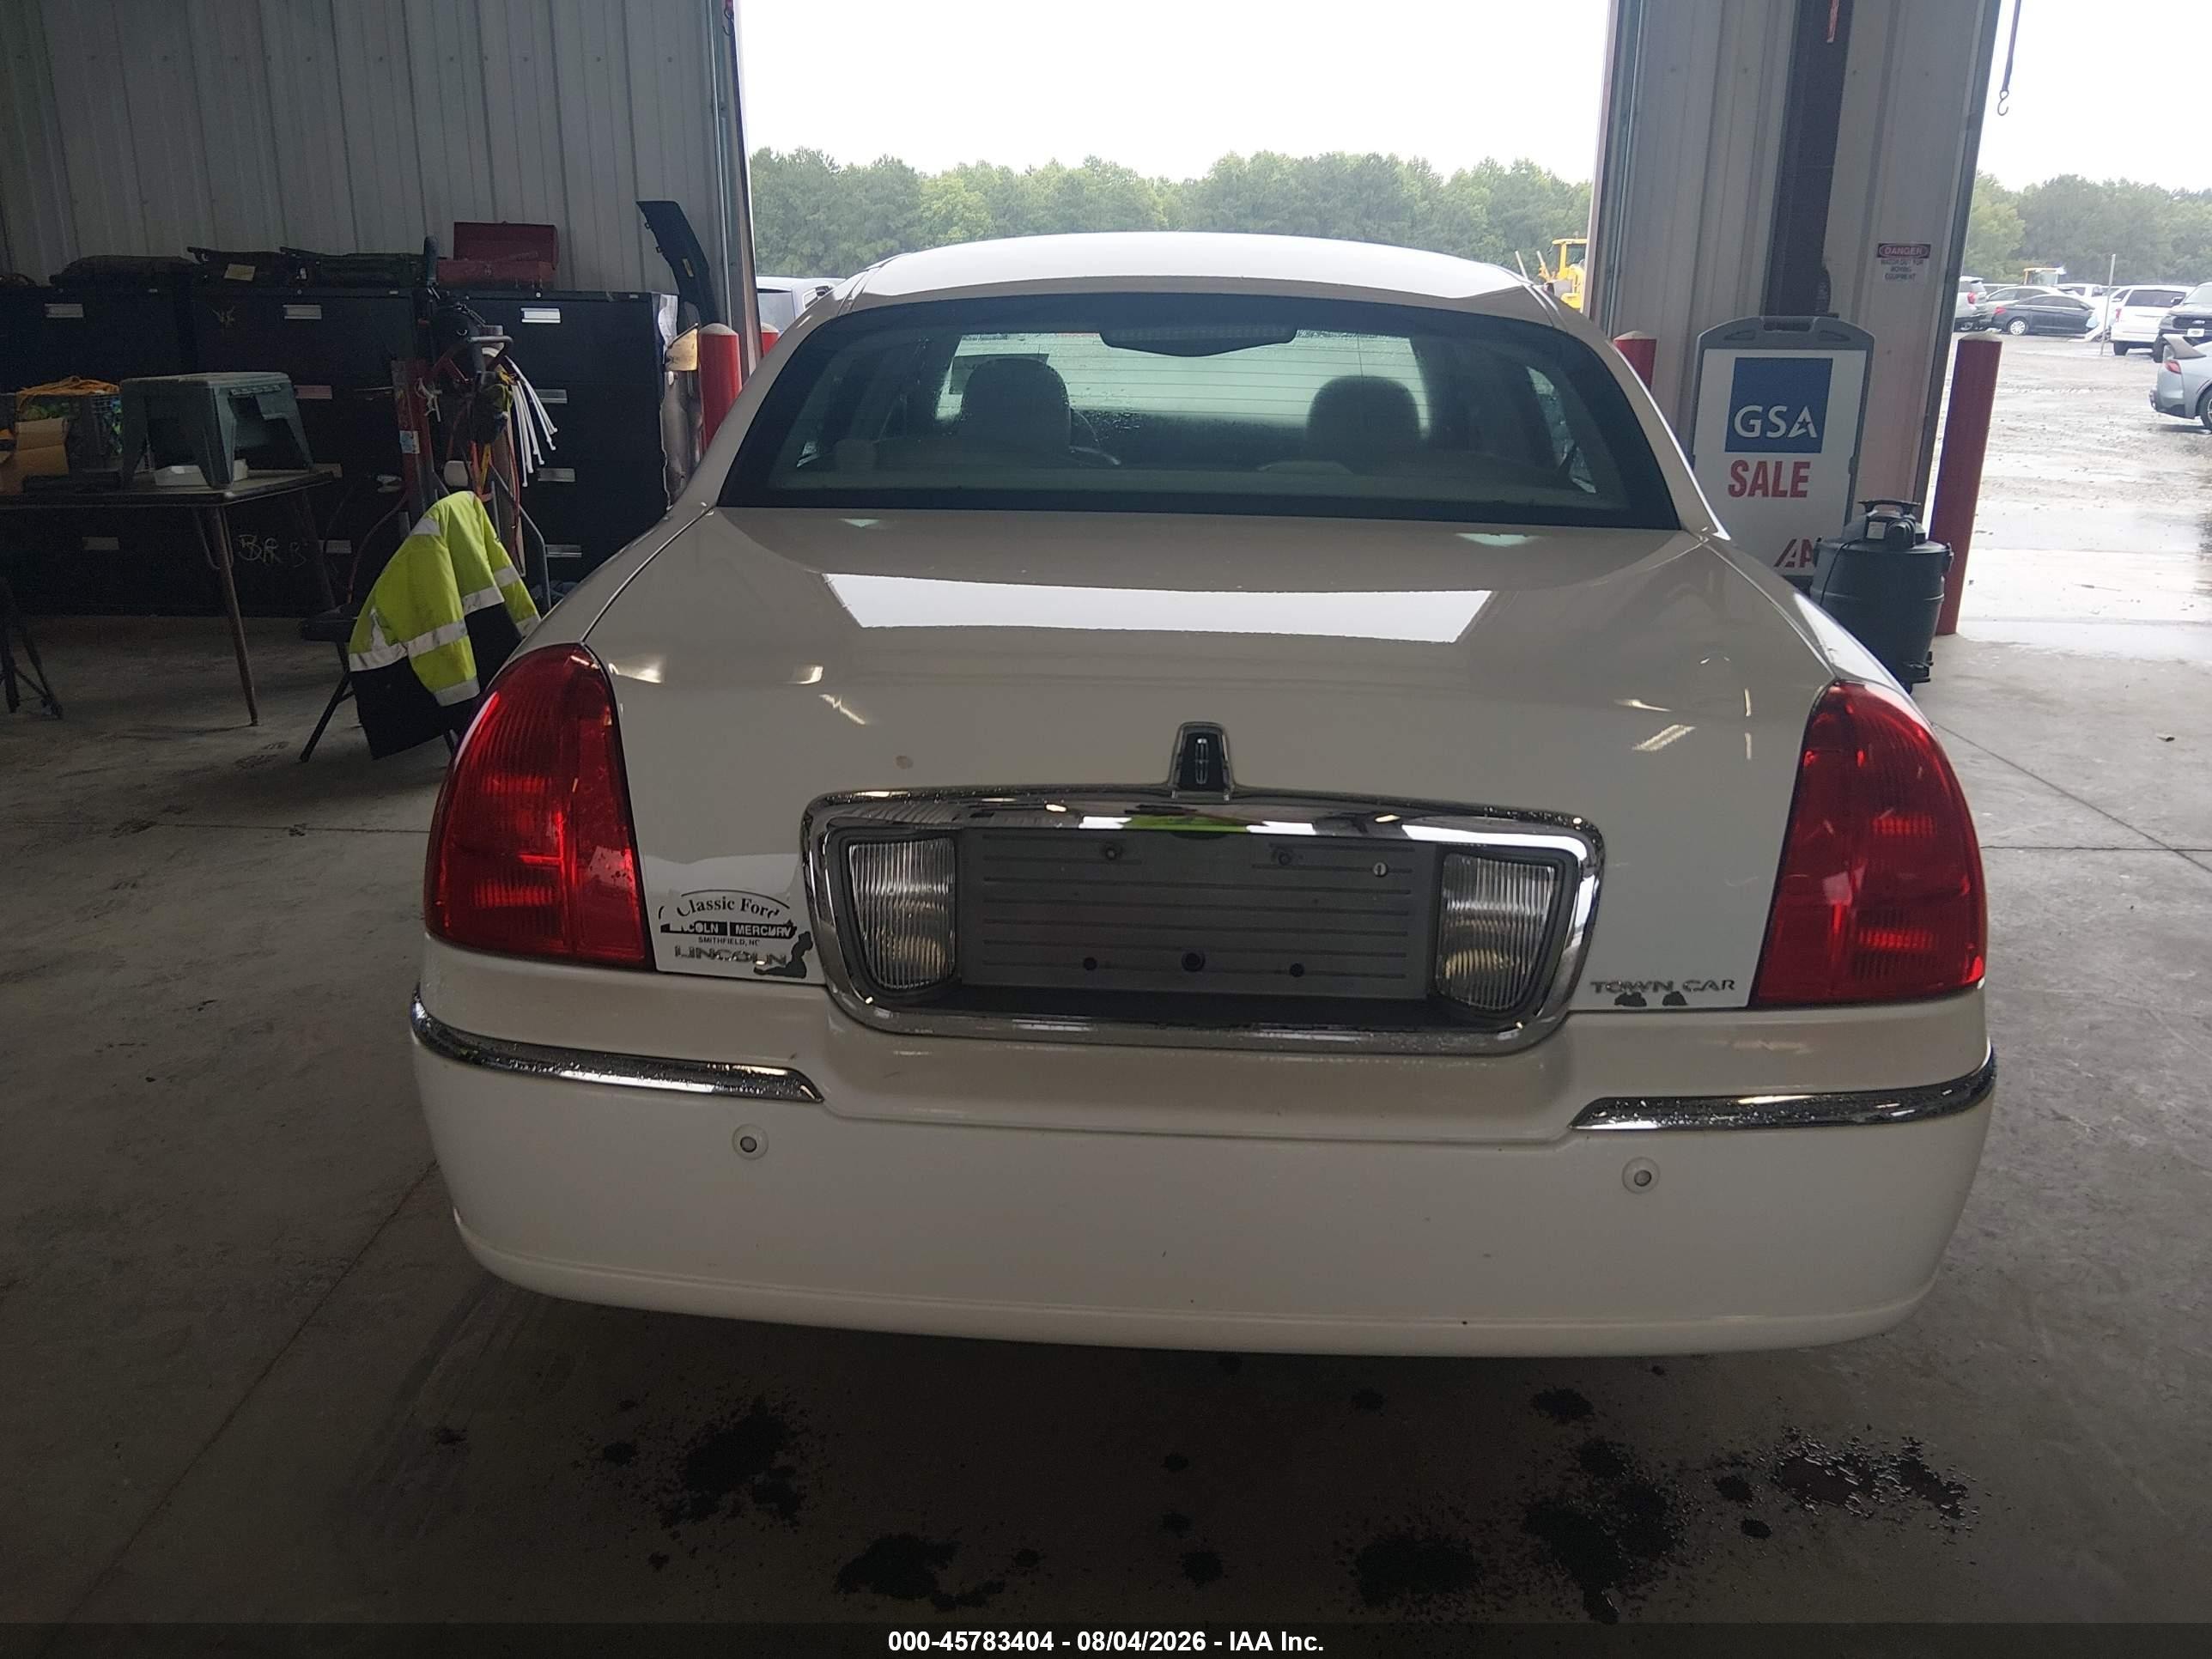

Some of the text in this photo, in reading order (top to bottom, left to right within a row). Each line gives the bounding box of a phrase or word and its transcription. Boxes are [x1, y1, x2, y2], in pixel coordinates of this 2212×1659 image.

[1884, 246, 1923, 255] DANGER
[1733, 404, 1818, 439] GSA
[1728, 459, 1811, 498] SALE
[677, 896, 735, 917] Classic
[735, 924, 792, 938] MERCURY
[674, 945, 787, 967] LINCOLN
[1590, 979, 1735, 994] TOWN CAR
